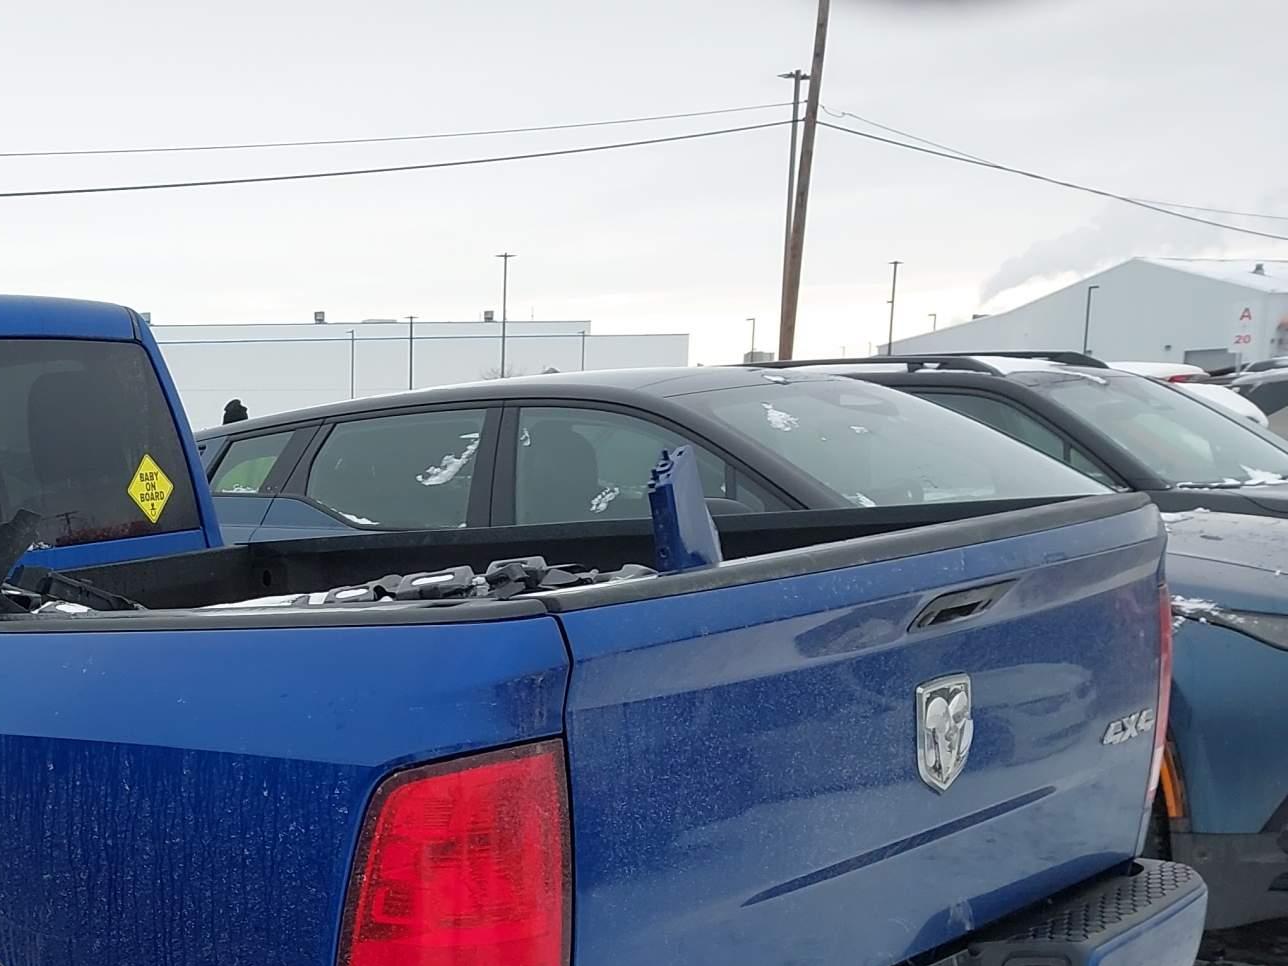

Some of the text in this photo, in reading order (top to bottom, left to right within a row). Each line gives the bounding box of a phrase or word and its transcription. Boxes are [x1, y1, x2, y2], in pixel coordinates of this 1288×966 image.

[1239, 307, 1252, 321] A
[1233, 334, 1252, 344] 20
[139, 471, 159, 482] BABY
[145, 481, 156, 492] ON
[139, 490, 165, 502] BOARD
